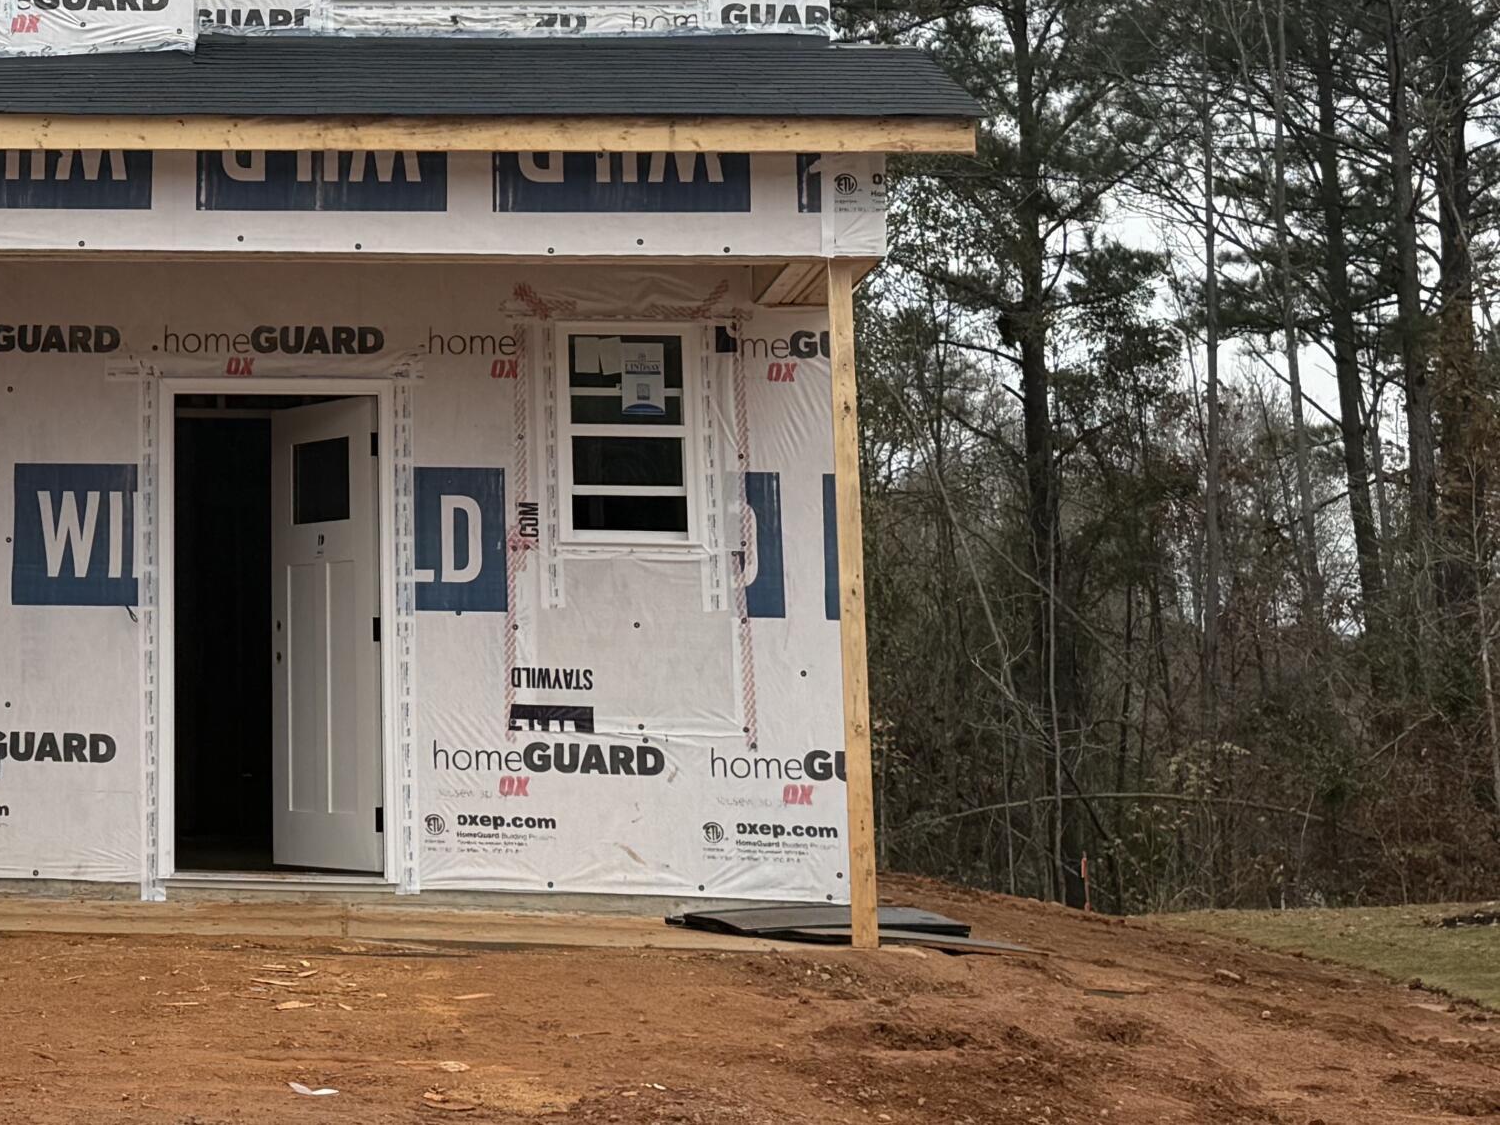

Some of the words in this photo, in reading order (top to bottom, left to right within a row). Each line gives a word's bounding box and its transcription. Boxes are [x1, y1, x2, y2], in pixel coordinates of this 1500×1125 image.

[164, 325, 385, 355] homeGUARD
[428, 326, 517, 355] home
[226, 357, 256, 376] OX
[490, 359, 518, 379] OX
[767, 362, 797, 382] OX
[510, 667, 593, 691] STAYWILD
[433, 740, 665, 776] homeGUARD
[498, 776, 531, 797] OX
[783, 784, 815, 806] OX
[457, 814, 557, 830] oxep.com
[735, 822, 839, 838] oxep.com
